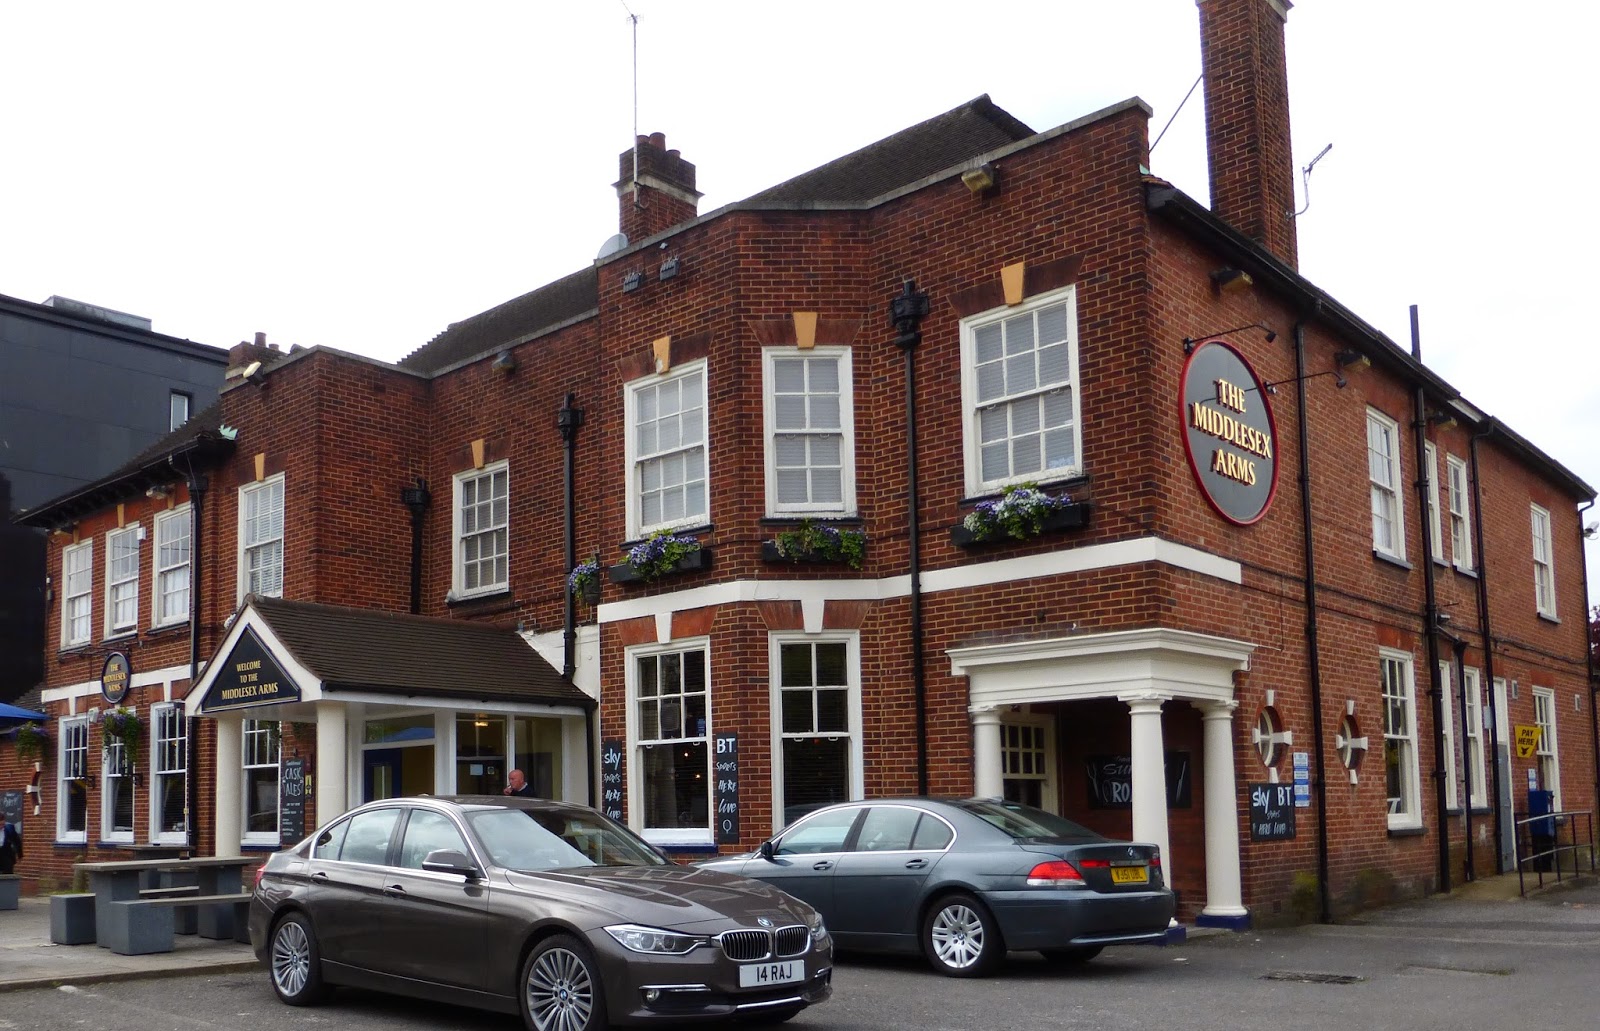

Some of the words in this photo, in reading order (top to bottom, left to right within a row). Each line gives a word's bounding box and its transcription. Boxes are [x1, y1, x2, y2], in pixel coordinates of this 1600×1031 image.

[1217, 379, 1247, 414] THE
[1194, 402, 1272, 459] MIDDLESEX
[1216, 449, 1257, 487] ARMS
[236, 660, 261, 672] WELCOME
[240, 675, 247, 684] TO
[248, 673, 258, 682] THE
[221, 685, 257, 700] MIDDLESEX
[258, 682, 279, 695] ARMS
[1521, 729, 1534, 737] PAY
[1518, 738, 1535, 746] HERE
[604, 748, 621, 770] sky
[285, 767, 301, 780] CASK
[286, 782, 301, 797] ALES
[718, 780, 737, 793] HERE
[1252, 786, 1270, 814] sky
[757, 966, 768, 982] 14
[771, 963, 792, 981] RAJ
